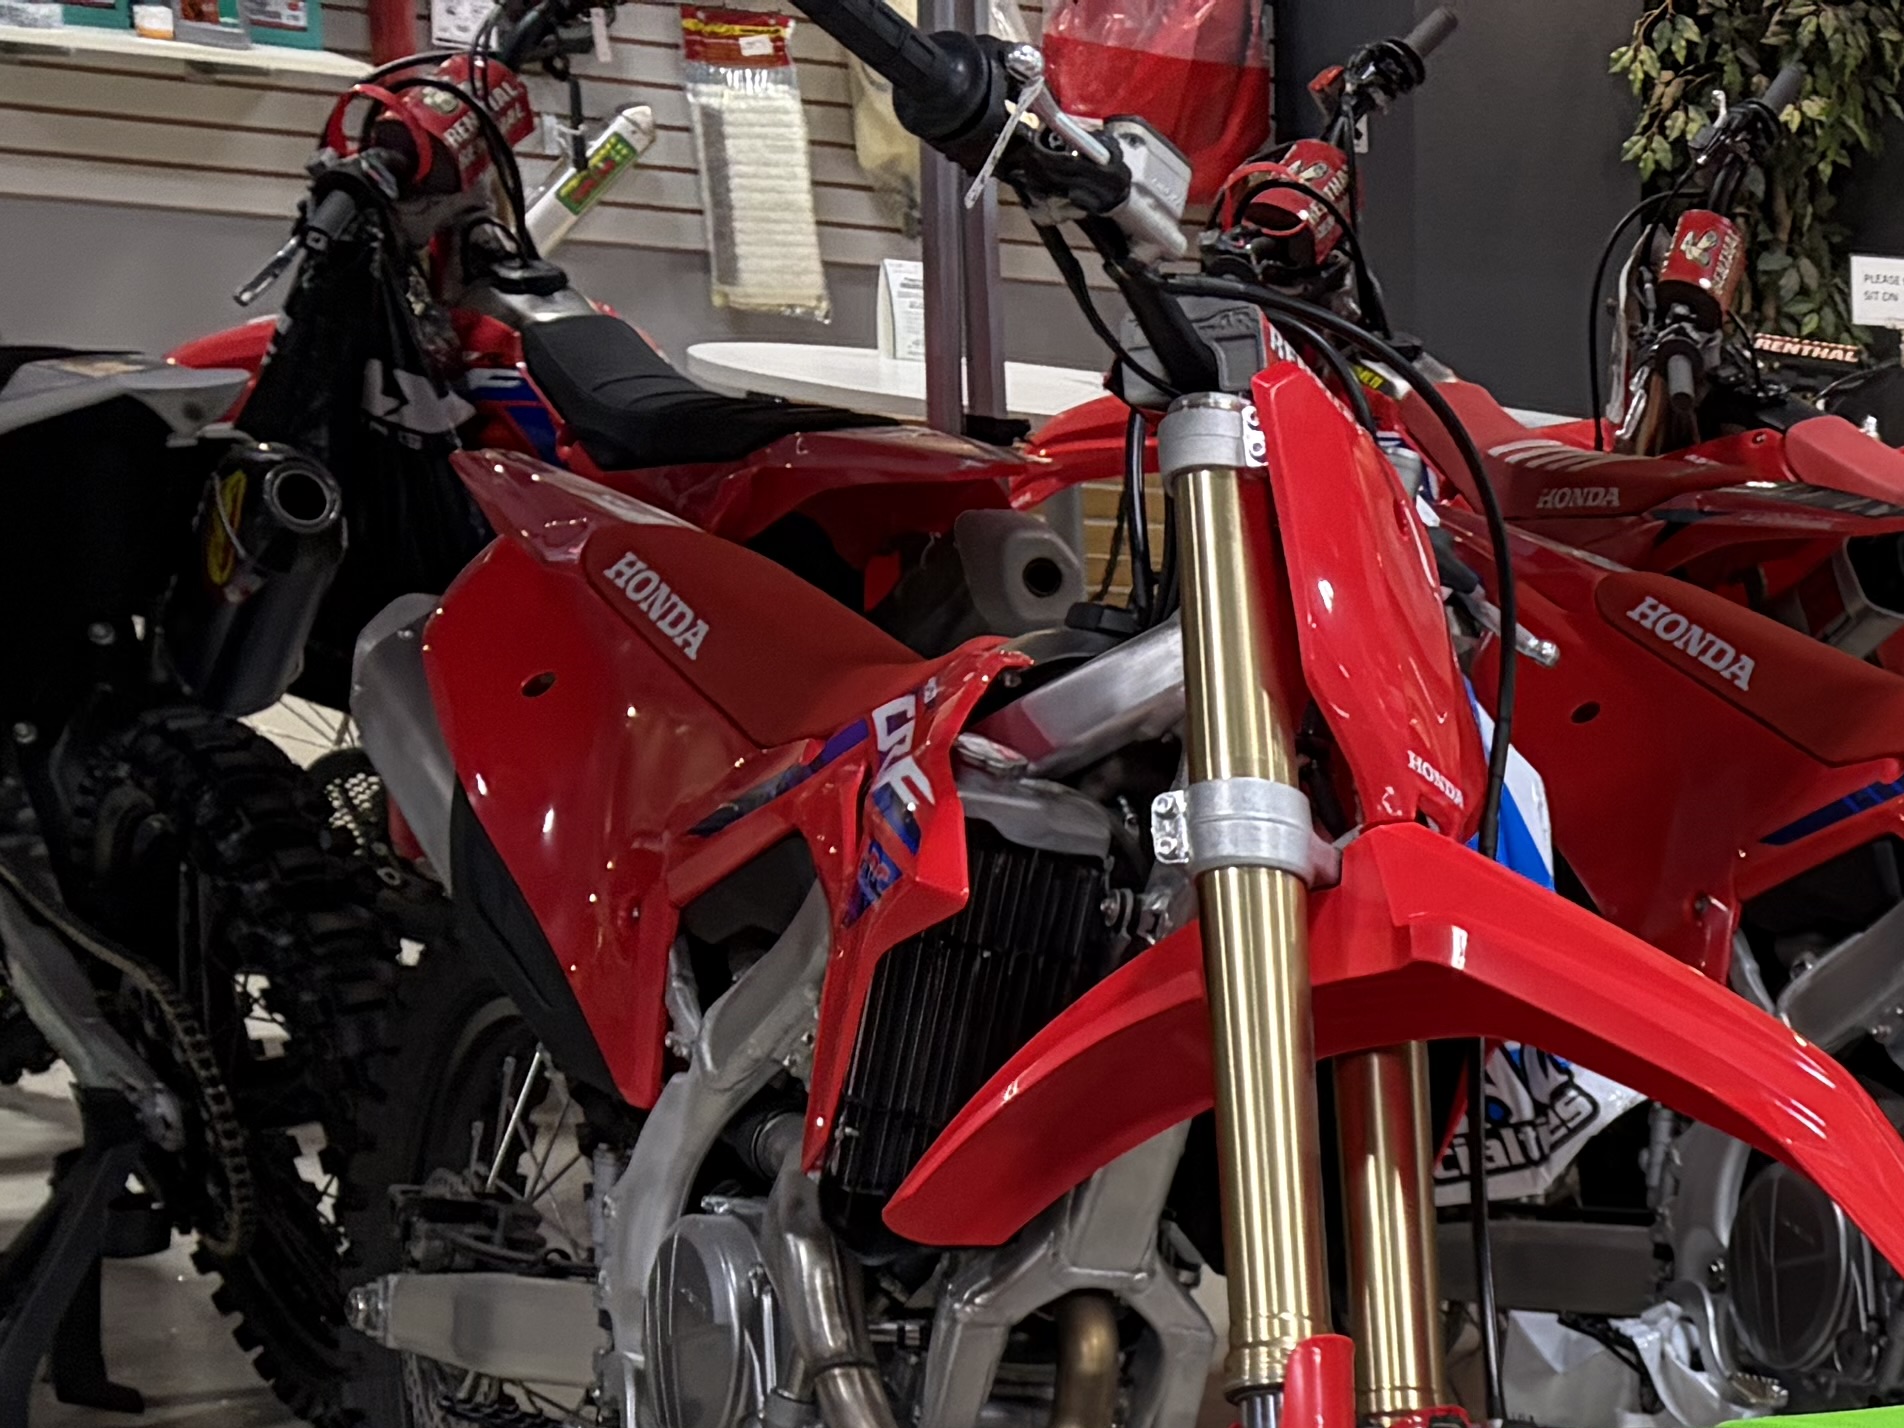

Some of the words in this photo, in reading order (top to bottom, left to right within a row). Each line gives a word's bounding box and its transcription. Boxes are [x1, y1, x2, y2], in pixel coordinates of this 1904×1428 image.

[443, 80, 519, 149] RENAL
[1755, 338, 1859, 363] RENTHAL
[1536, 487, 1621, 509] HONDA
[603, 551, 710, 661] HONDA
[1626, 596, 1756, 692] HONDA
[871, 693, 936, 806] CRF
[1407, 749, 1464, 810] HONDA
